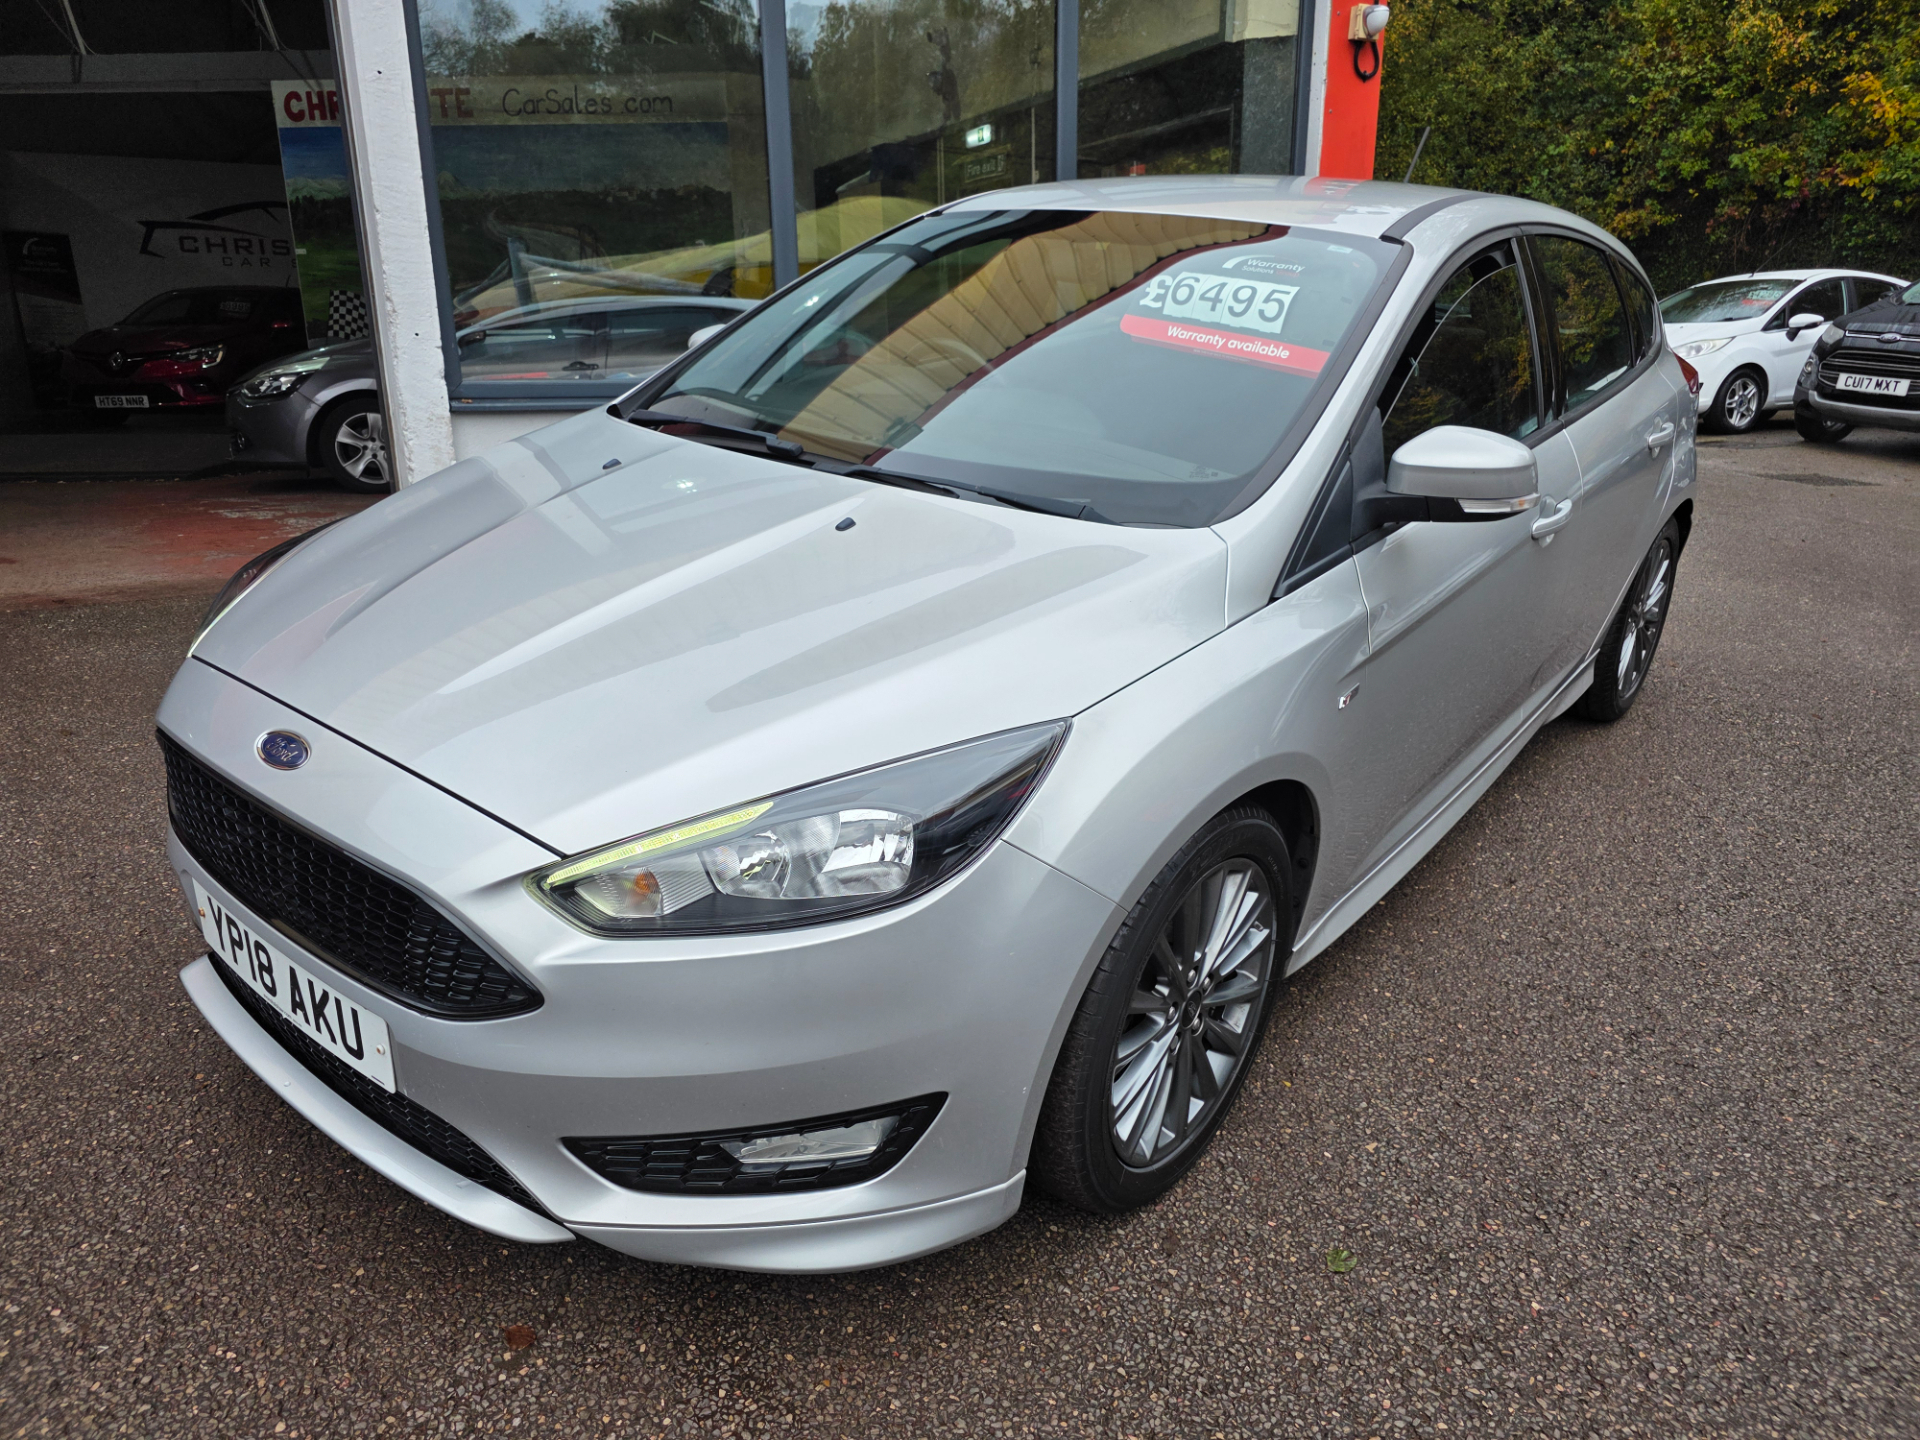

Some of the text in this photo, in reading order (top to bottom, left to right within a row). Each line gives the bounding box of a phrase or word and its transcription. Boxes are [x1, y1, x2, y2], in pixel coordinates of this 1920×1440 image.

[284, 90, 339, 123] CHR
[178, 235, 291, 256] CHRIS
[222, 256, 271, 268] CAR
[1241, 265, 1274, 275] Solutions
[1247, 258, 1306, 273] Warranty
[1139, 275, 1291, 323] £6495
[1167, 325, 1226, 349] Warranty
[1227, 339, 1290, 359] available
[1844, 375, 1901, 392] CU17 MXT
[98, 396, 145, 407] HT69 NNR
[265, 739, 299, 762] Ford
[207, 896, 365, 1061] YP18 AKU
